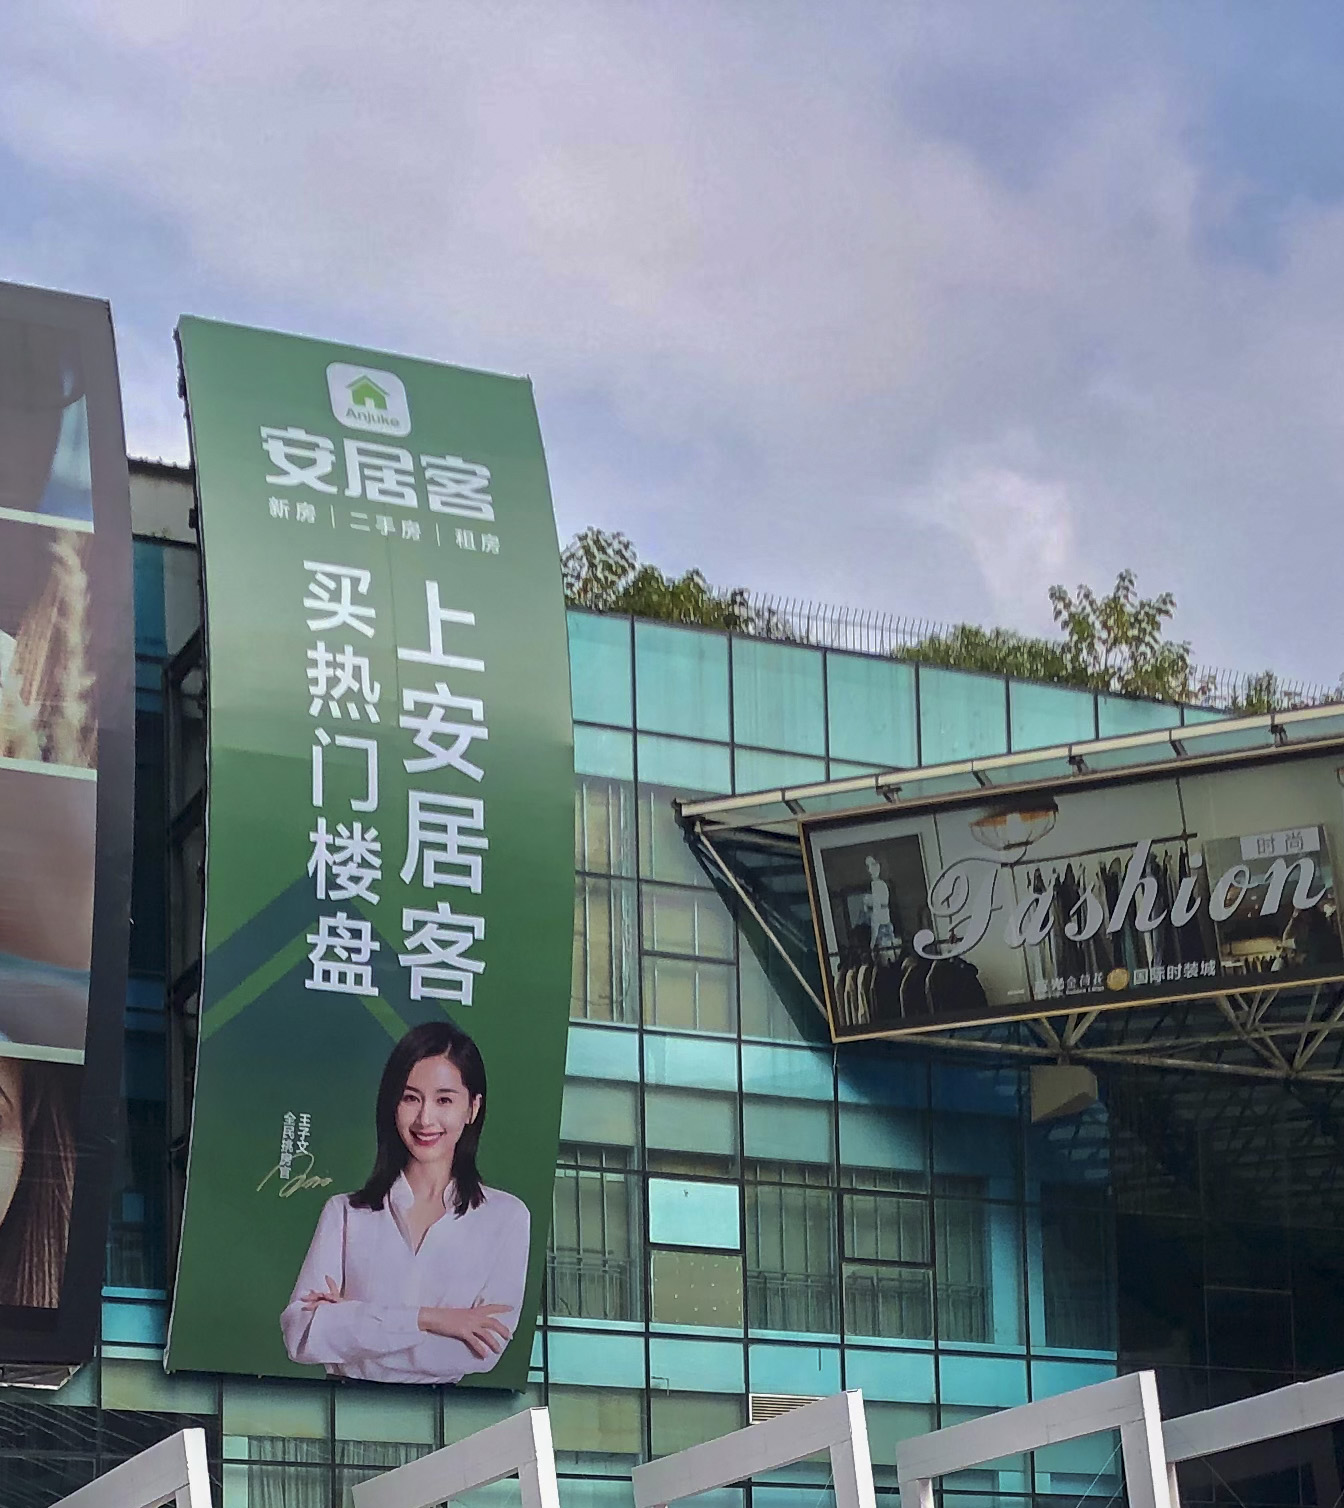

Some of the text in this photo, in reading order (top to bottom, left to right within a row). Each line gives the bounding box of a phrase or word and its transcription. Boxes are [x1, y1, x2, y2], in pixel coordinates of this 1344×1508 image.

[345, 406, 400, 428] Anjuke
[260, 426, 495, 522] 安居客
[303, 559, 383, 998] 买热门楼盘
[396, 579, 490, 1007] 上安居客
[1256, 833, 1306, 856] 时尚
[912, 838, 1327, 961] Fashion
[295, 1113, 312, 1155] 王子文
